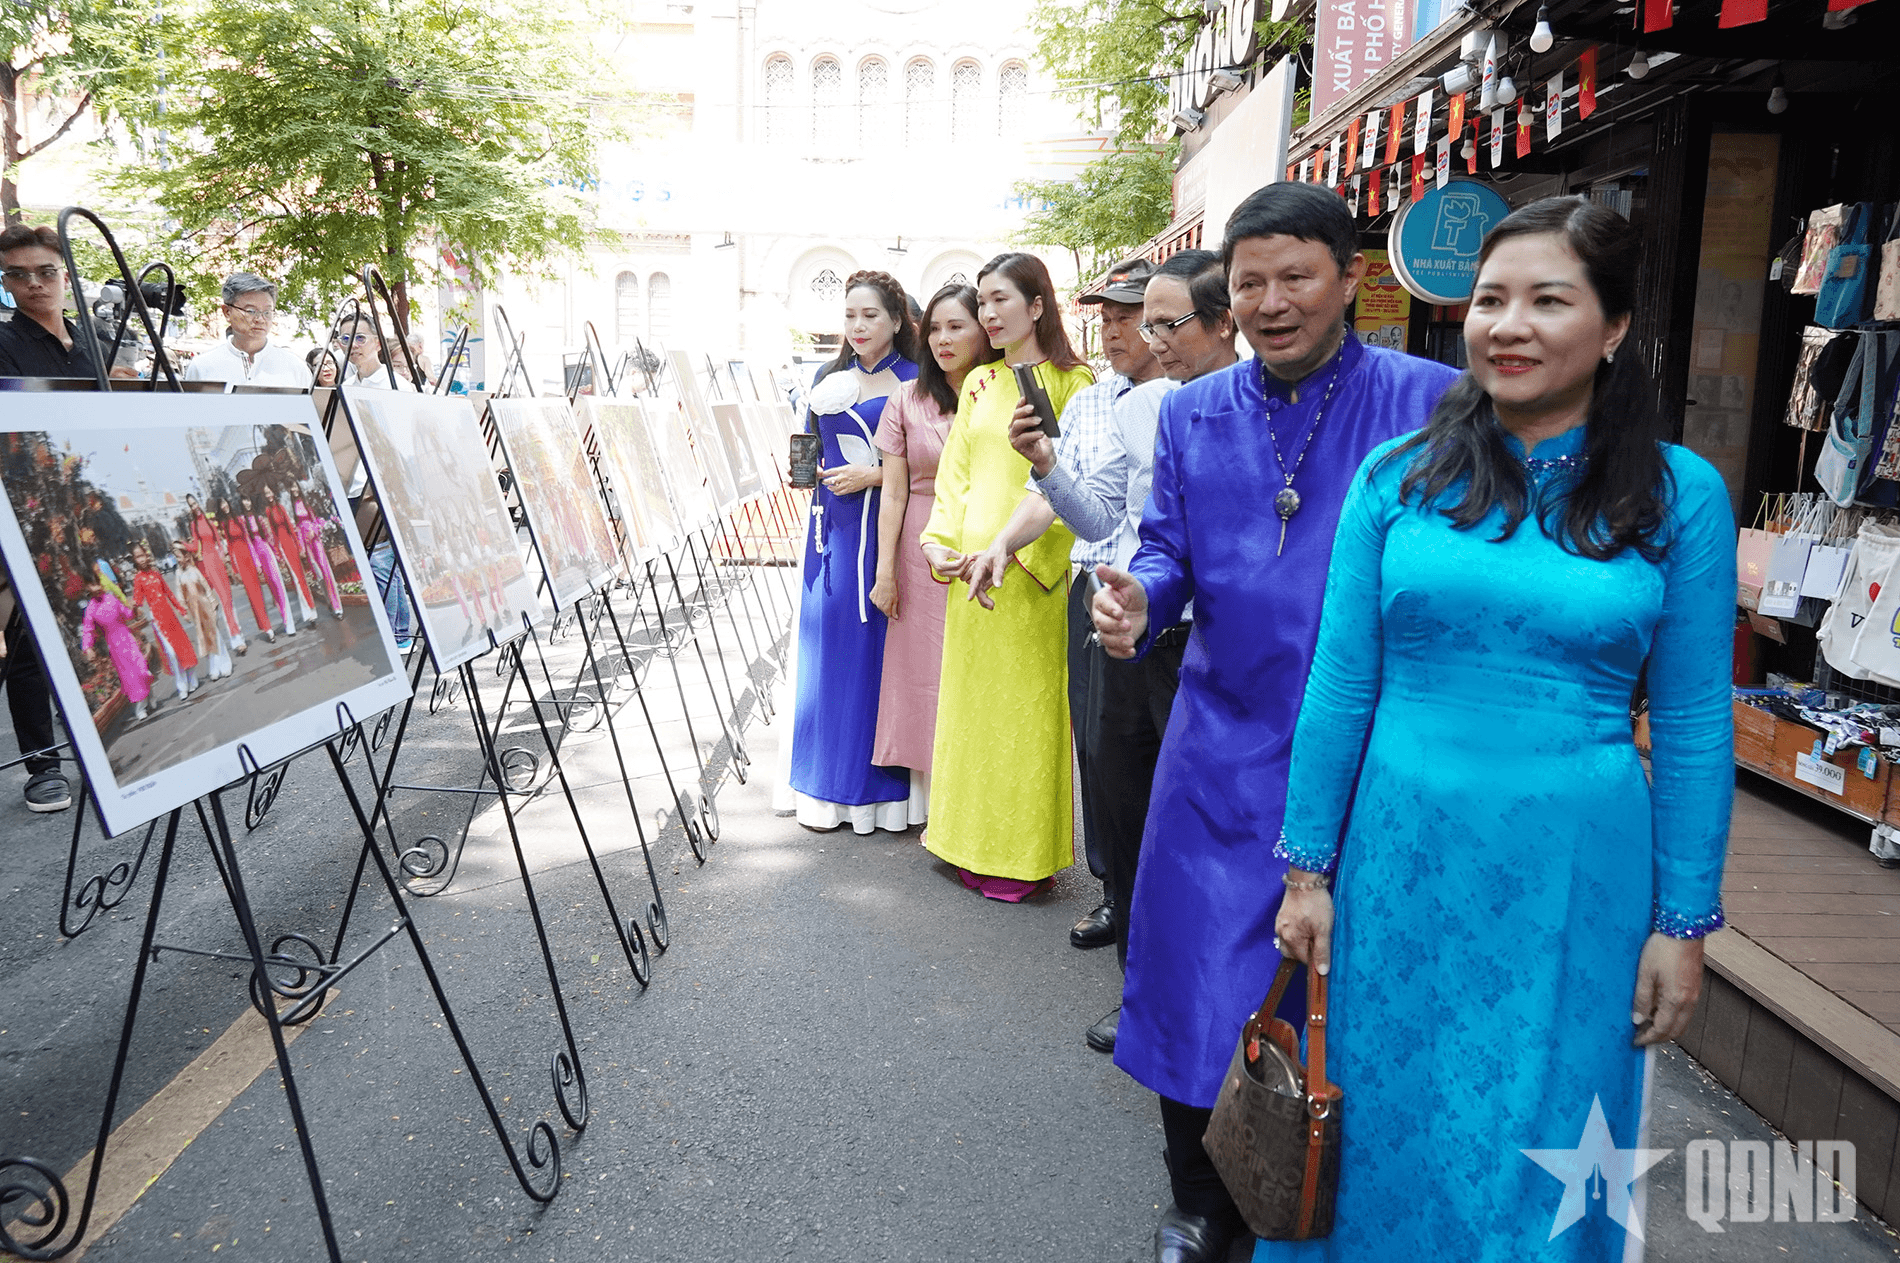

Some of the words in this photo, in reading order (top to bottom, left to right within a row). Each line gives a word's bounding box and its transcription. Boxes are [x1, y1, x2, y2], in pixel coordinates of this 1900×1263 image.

[1360, 15, 1385, 61] PHỐ
[1393, 0, 1405, 40] GENER
[1328, 36, 1354, 92] XUẤT
